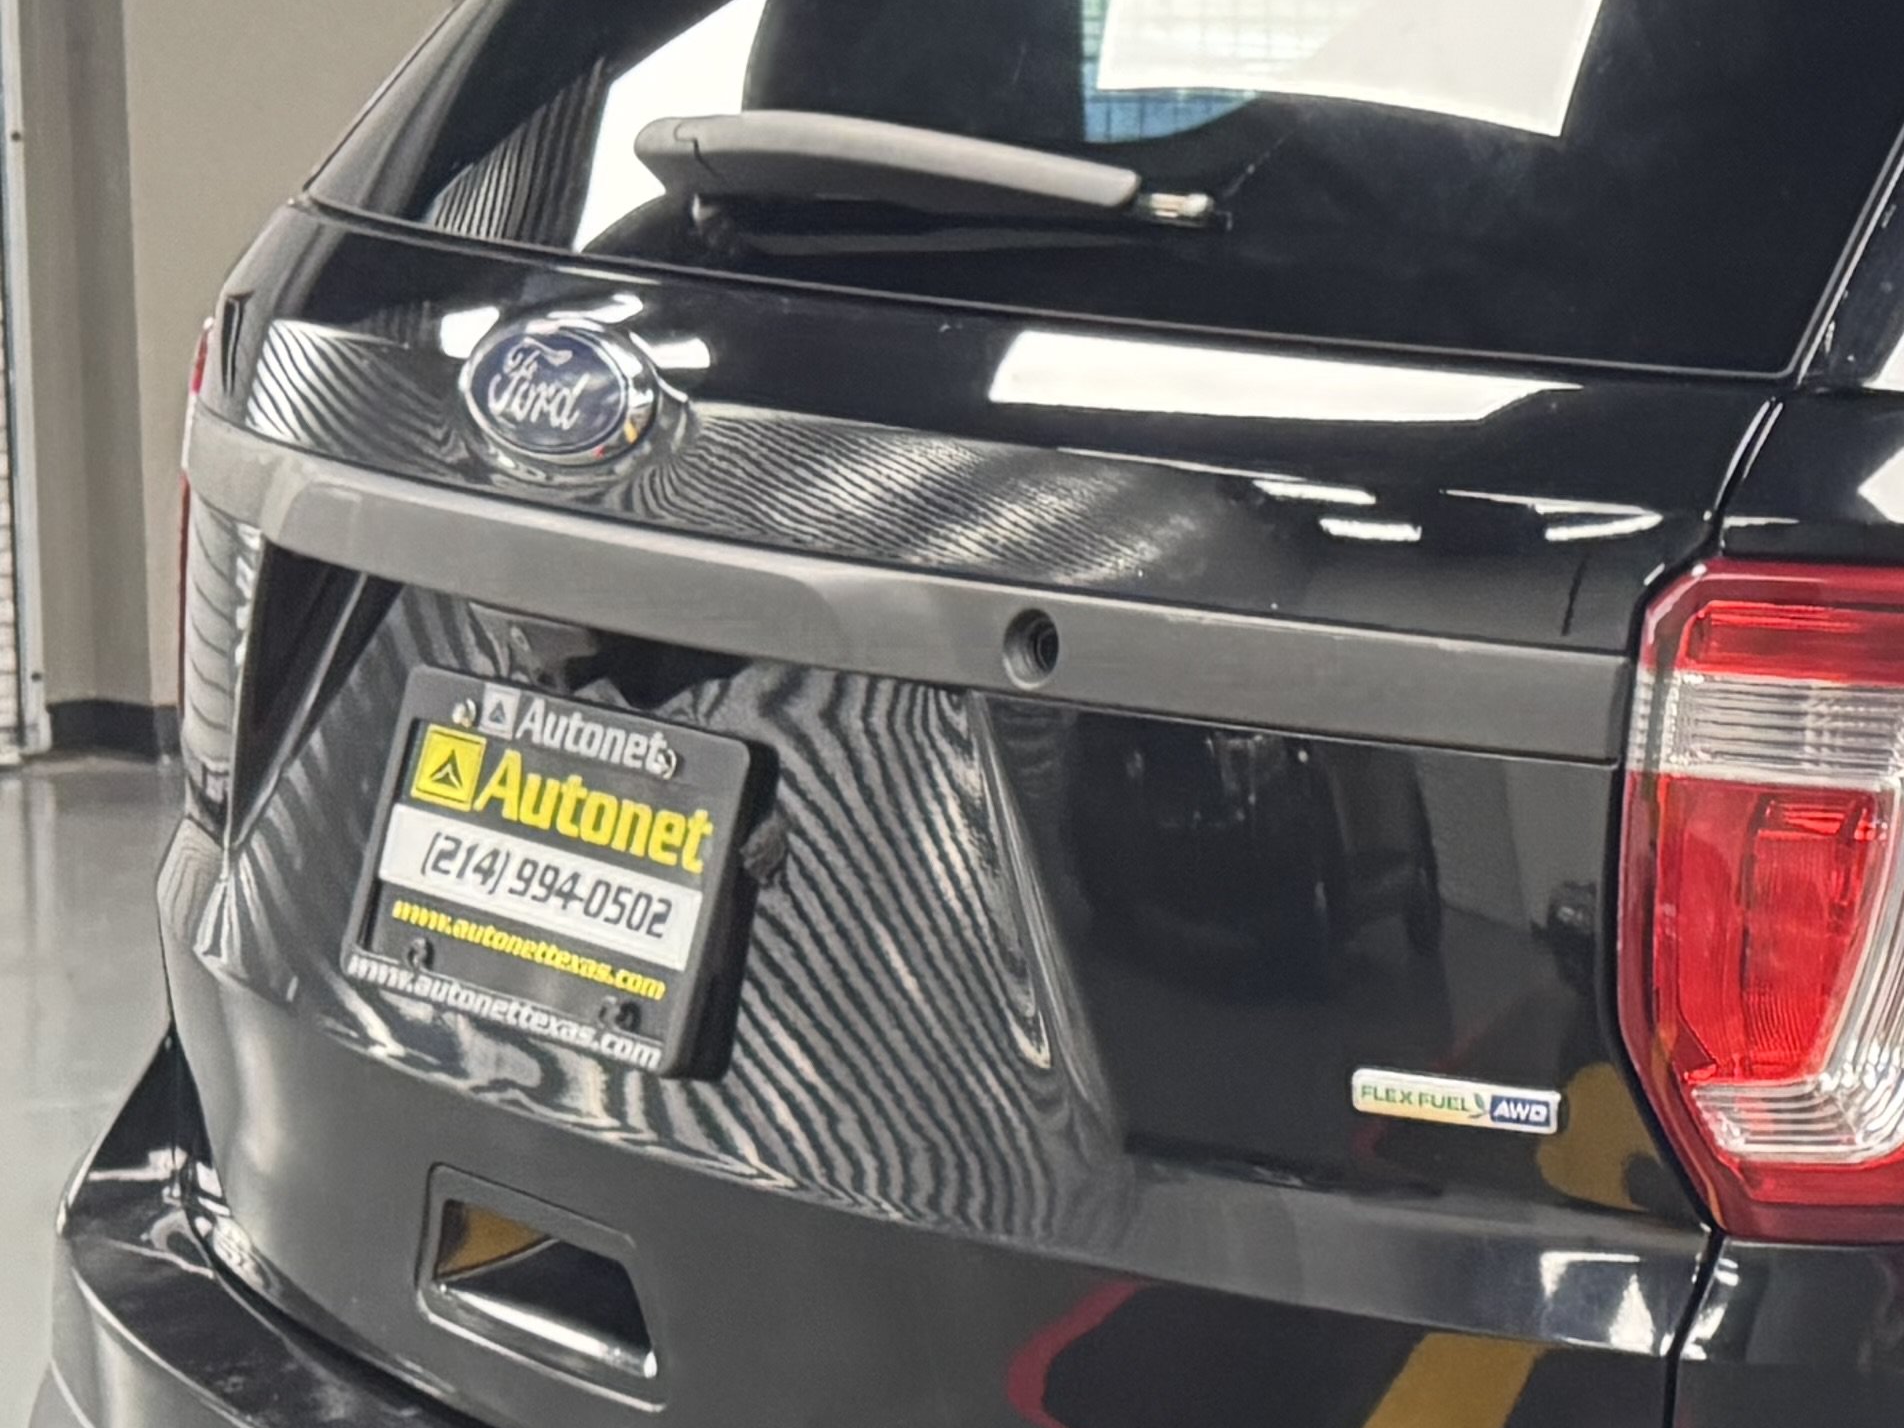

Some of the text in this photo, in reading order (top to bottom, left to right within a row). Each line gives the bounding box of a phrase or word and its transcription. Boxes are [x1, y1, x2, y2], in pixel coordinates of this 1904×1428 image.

[488, 336, 590, 430] Ford
[514, 698, 669, 777] Autonet
[473, 748, 714, 874] Autonet
[421, 831, 673, 939] (214) 994-0502
[391, 899, 667, 1001] www.autonettexas.com
[347, 953, 663, 1070] www.autonettexas.com
[1360, 1083, 1548, 1122] FLEX FUEL AWD
